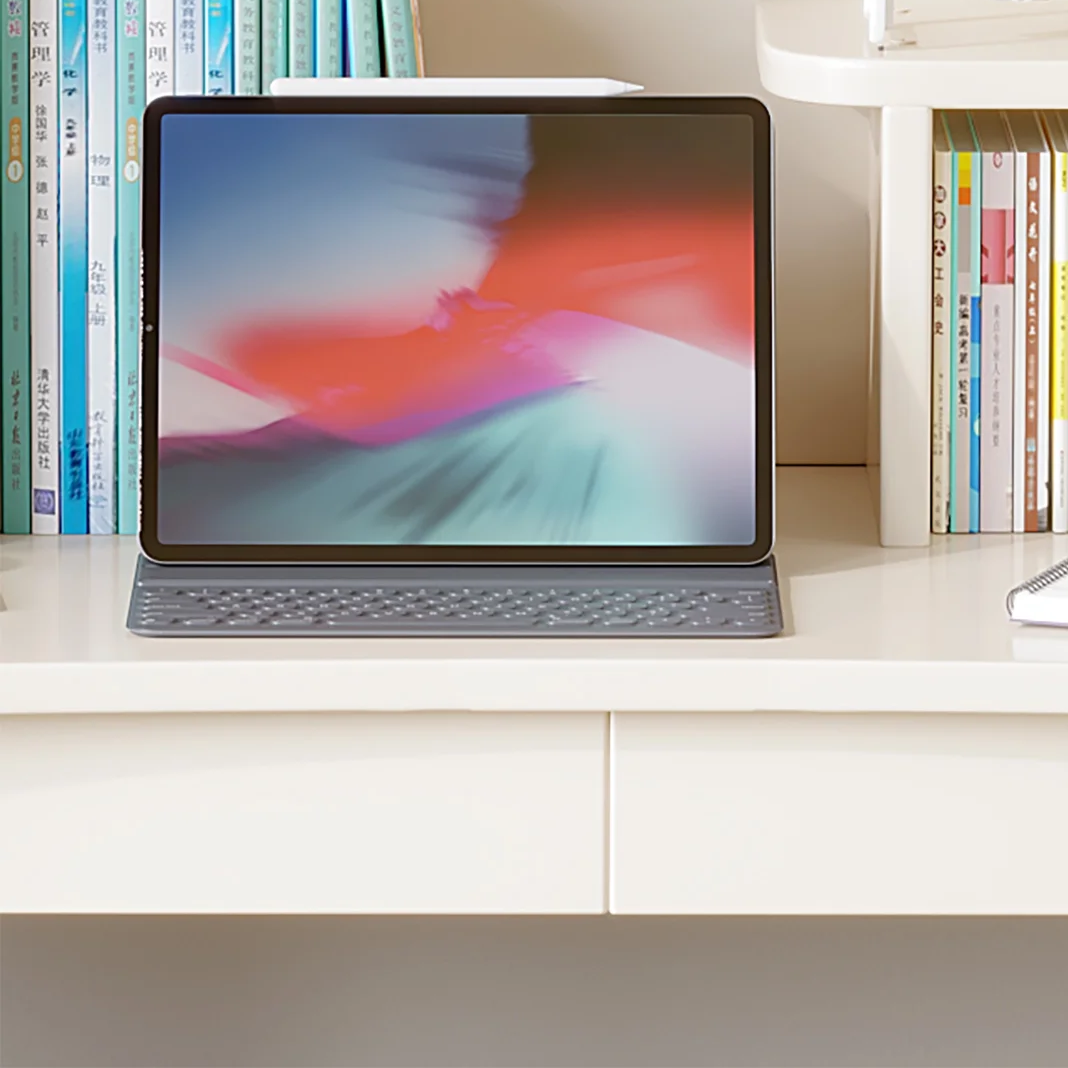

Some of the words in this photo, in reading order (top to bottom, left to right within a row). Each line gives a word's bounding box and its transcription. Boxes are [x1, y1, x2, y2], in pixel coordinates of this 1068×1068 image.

[31, 20, 52, 88] 管理学
[149, 20, 168, 88] 管理学
[91, 154, 111, 187] 物理
[90, 260, 106, 295] 九年级
[37, 367, 50, 469] 清华大学出版社
